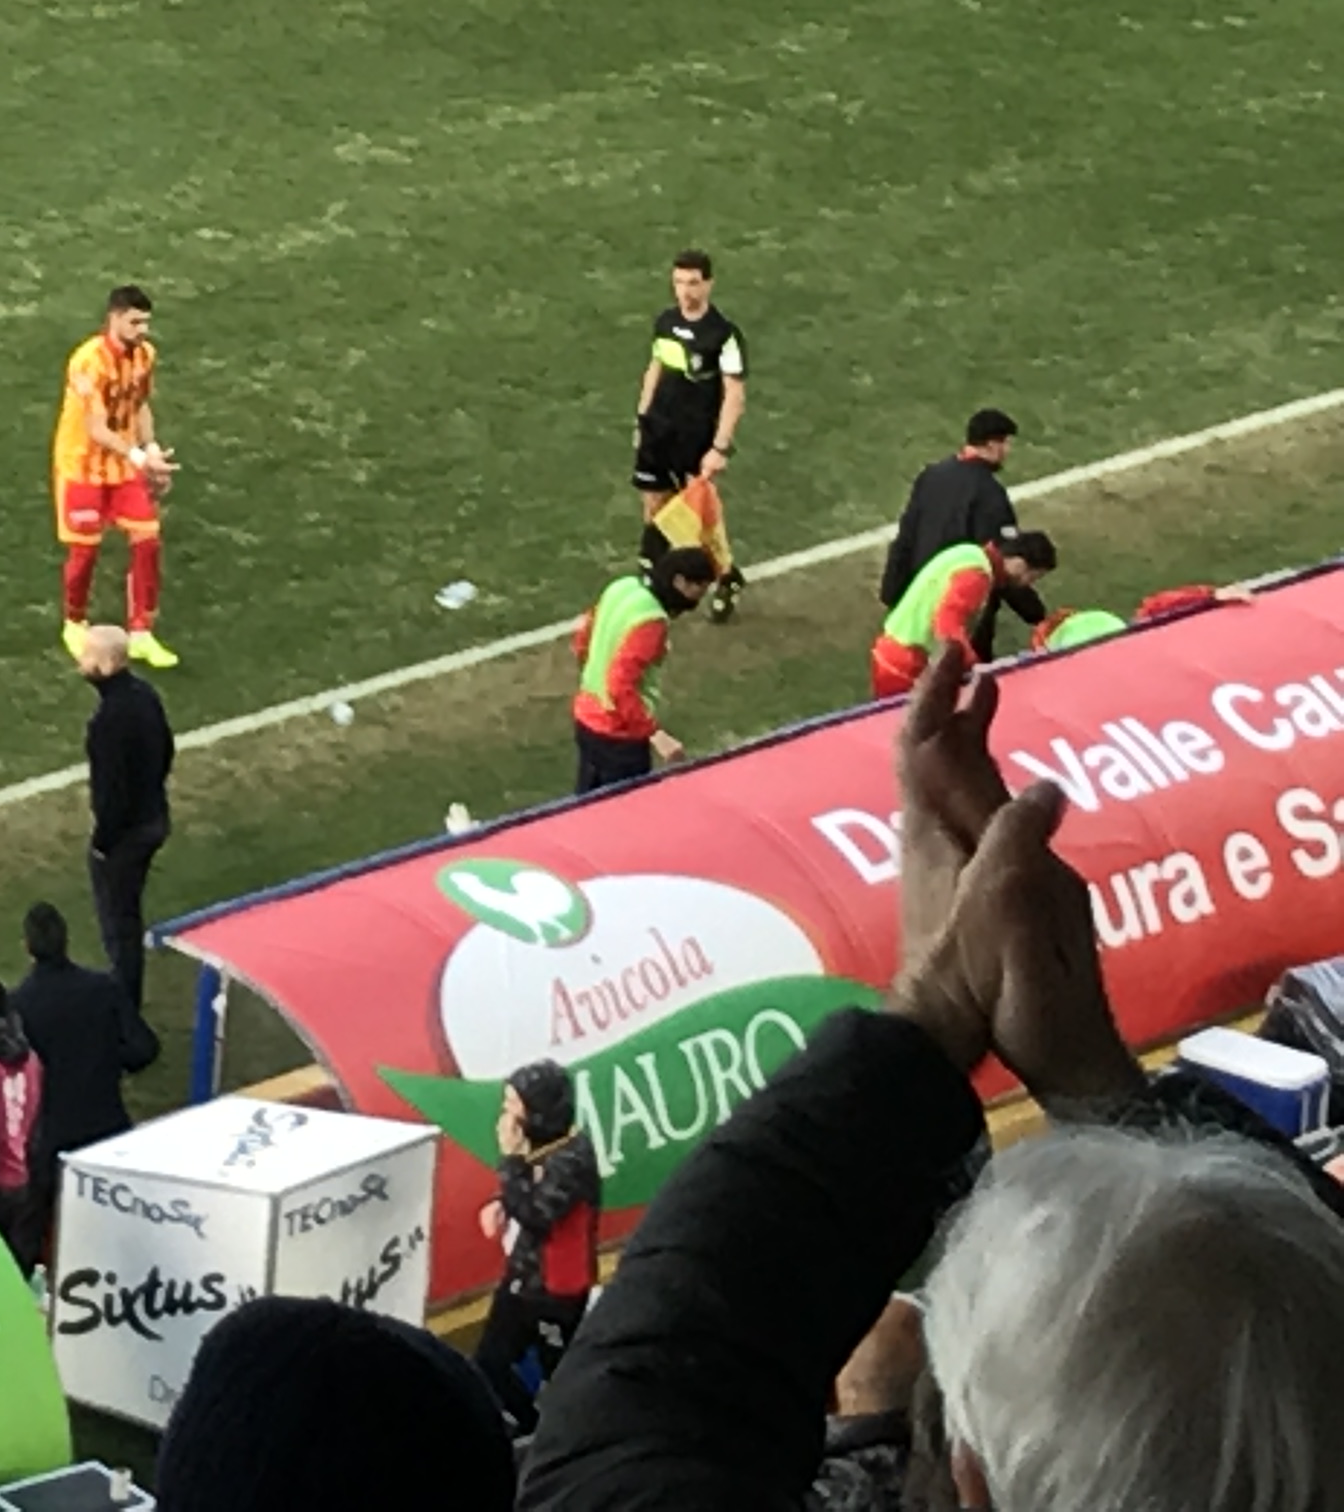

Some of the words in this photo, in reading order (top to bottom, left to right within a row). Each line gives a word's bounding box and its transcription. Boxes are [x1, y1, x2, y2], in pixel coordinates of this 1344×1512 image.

[811, 807, 902, 886] D
[1008, 716, 1225, 813] Valle
[1087, 850, 1217, 949] ura
[1223, 830, 1274, 900] e
[1275, 787, 1344, 880] S
[549, 927, 715, 1046] Avicola
